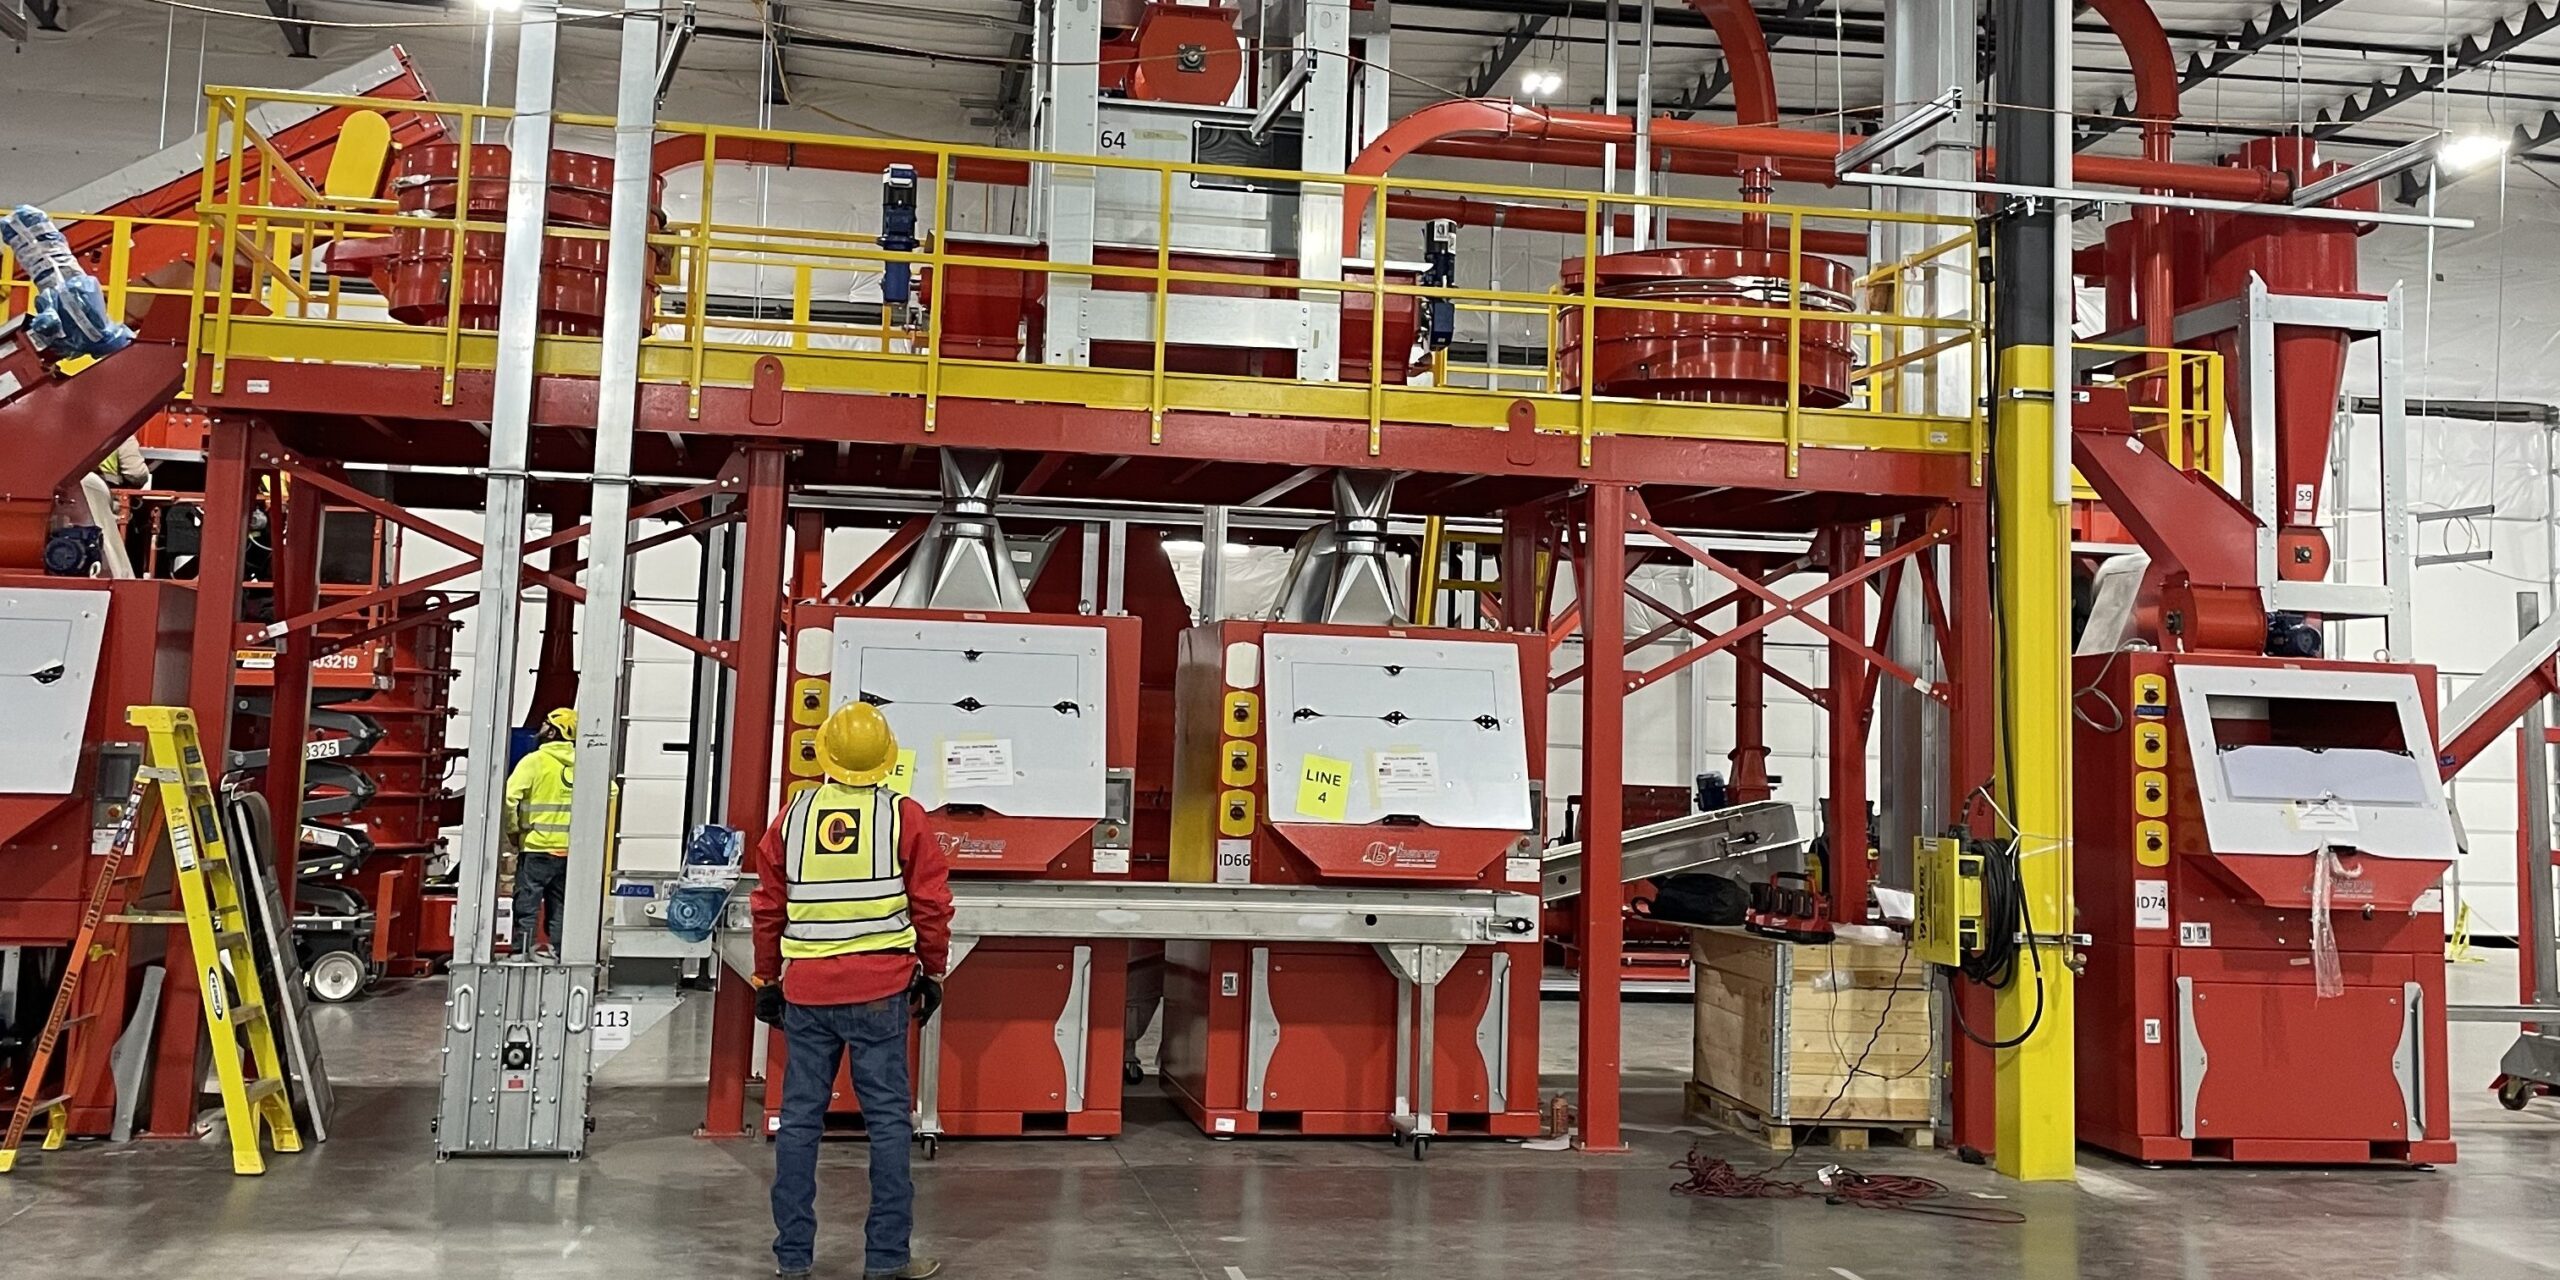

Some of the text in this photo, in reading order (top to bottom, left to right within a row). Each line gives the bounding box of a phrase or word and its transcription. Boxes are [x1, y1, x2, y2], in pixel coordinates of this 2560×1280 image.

[1100, 130, 1126, 149] 64
[2298, 490, 2312, 502] 59
[1306, 768, 1342, 787] LINE
[1317, 792, 1327, 804] 4
[1219, 853, 1251, 867] ID66
[2136, 896, 2167, 910] ID74
[594, 1010, 629, 1027] 113
